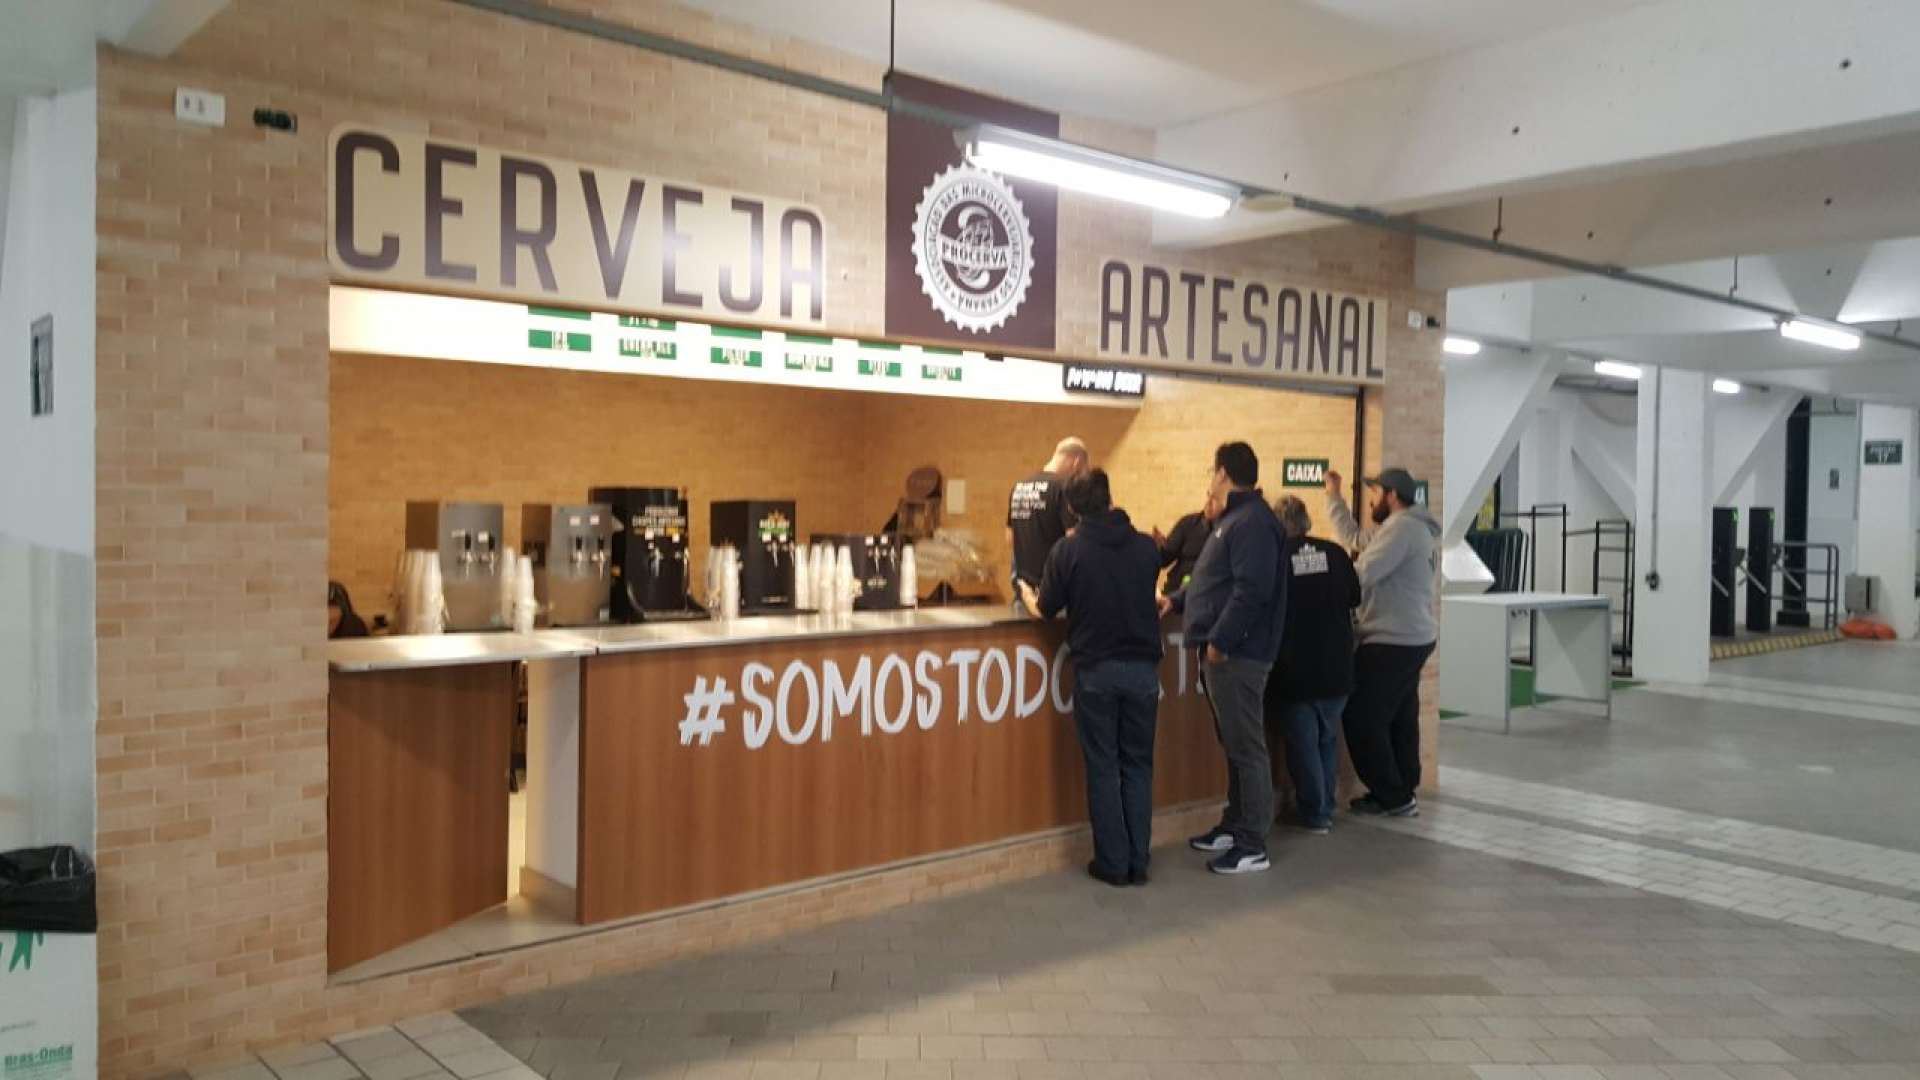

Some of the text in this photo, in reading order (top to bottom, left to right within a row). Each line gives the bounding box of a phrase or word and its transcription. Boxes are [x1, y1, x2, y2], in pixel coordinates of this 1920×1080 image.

[334, 130, 823, 321] CERVEJA
[941, 240, 1008, 264] PROCERVA
[1100, 260, 1384, 379] ARTESANAL
[1286, 463, 1322, 482] CAIXA
